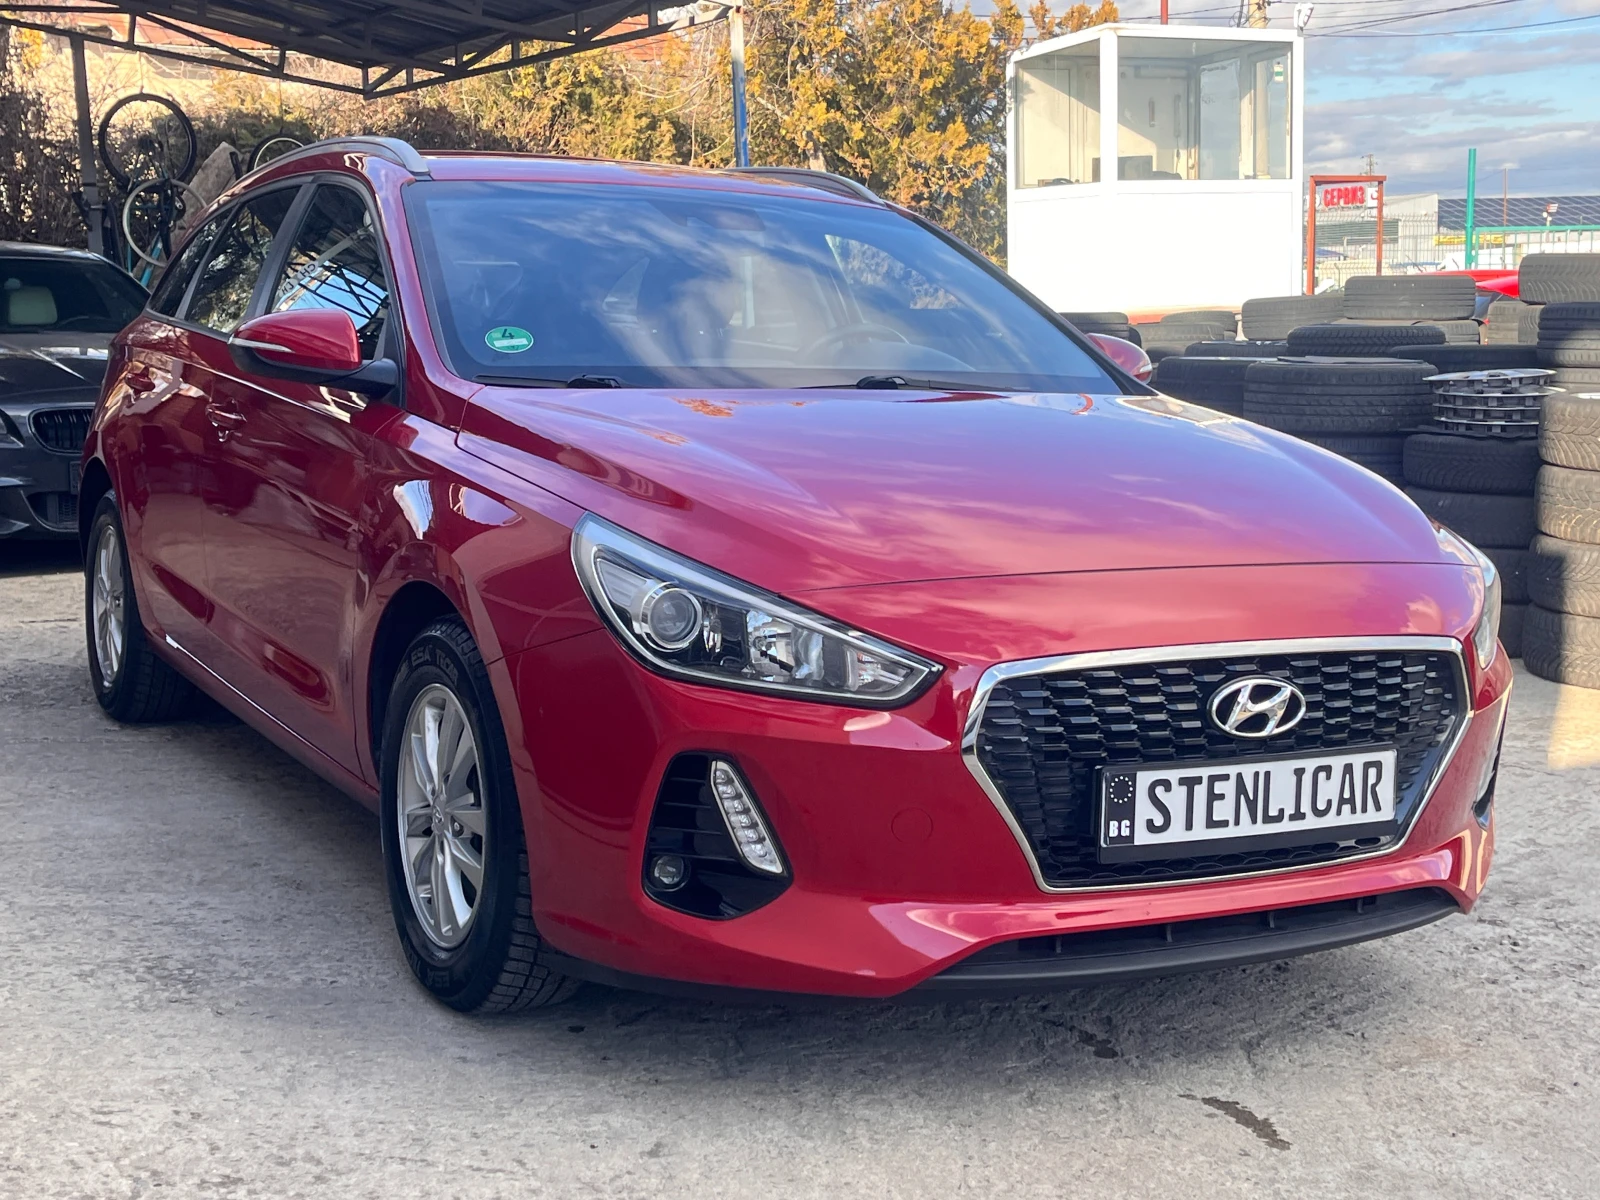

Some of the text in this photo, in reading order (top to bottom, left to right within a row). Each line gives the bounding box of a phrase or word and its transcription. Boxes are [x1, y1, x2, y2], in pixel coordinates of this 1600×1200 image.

[1323, 186, 1365, 207] СЕРВИЗ
[501, 328, 515, 339] 4
[1108, 760, 1384, 838] BG STENLICAR
